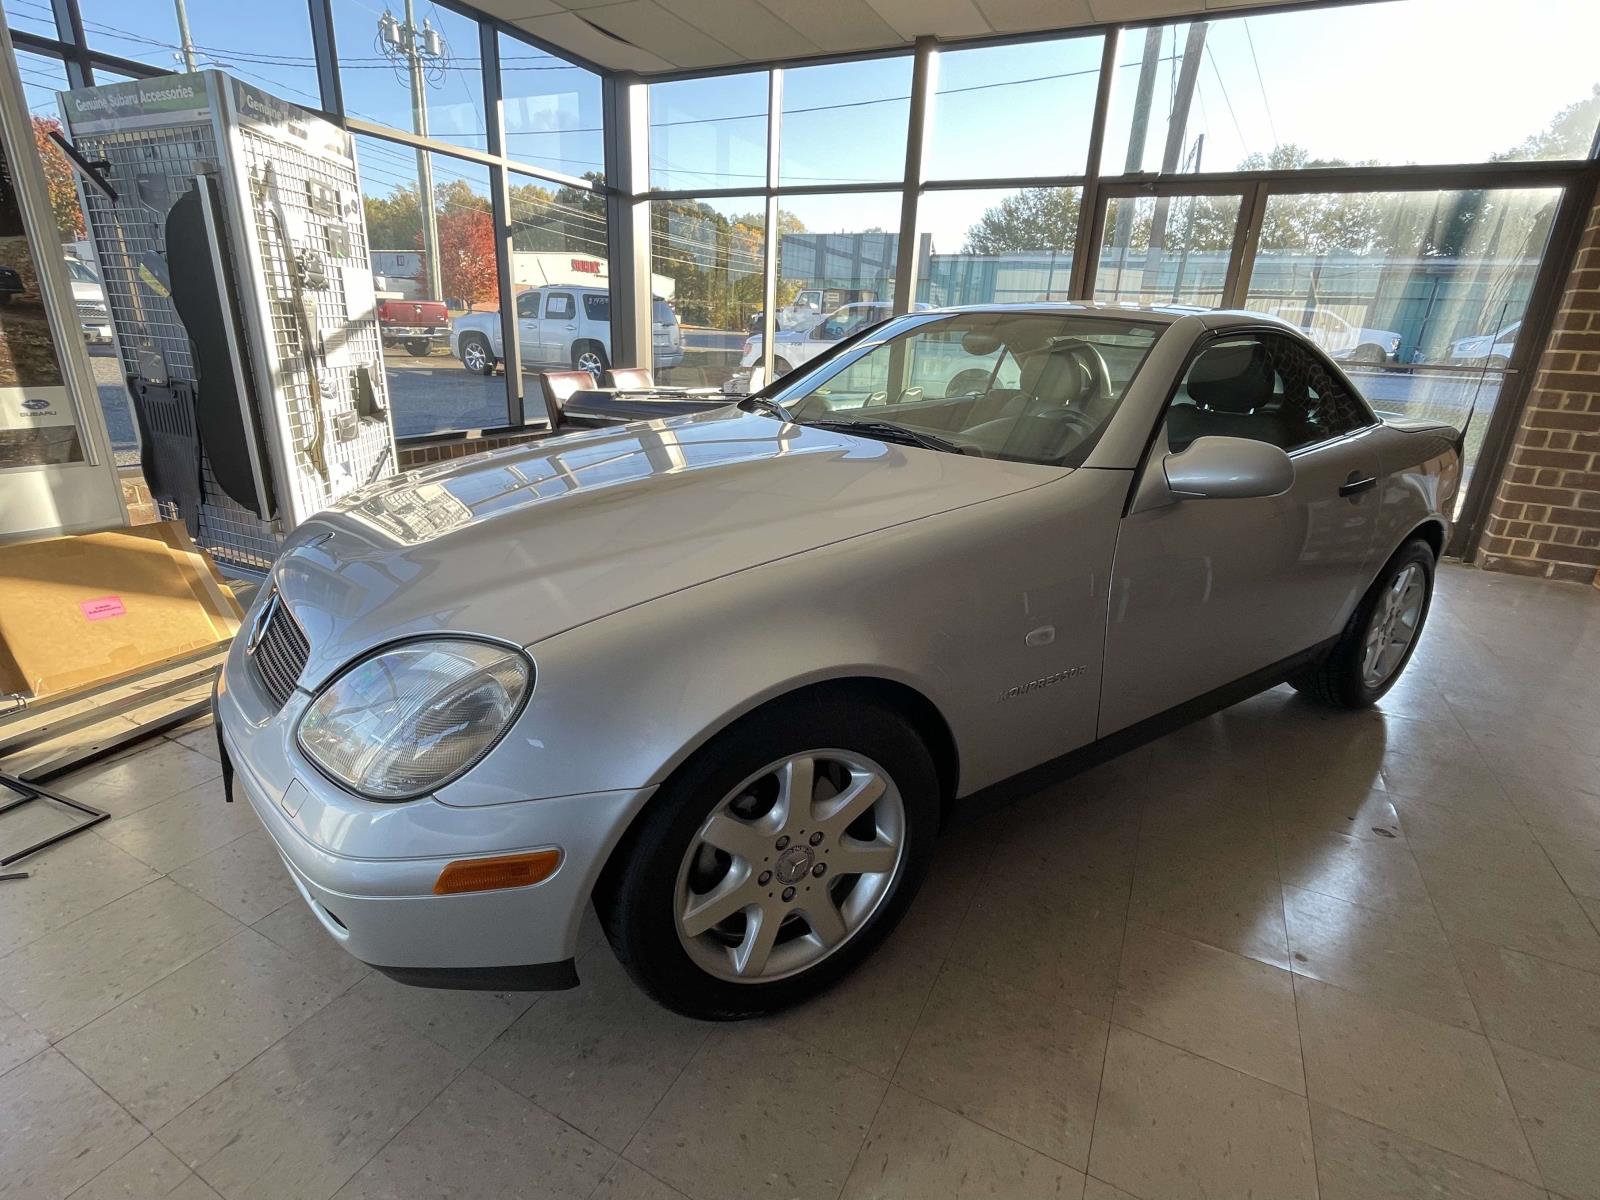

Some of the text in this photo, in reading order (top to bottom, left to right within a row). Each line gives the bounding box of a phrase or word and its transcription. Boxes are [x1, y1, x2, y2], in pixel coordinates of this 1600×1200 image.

[76, 84, 195, 112] Genuine Subaru Accessories
[246, 94, 283, 121] Genuine
